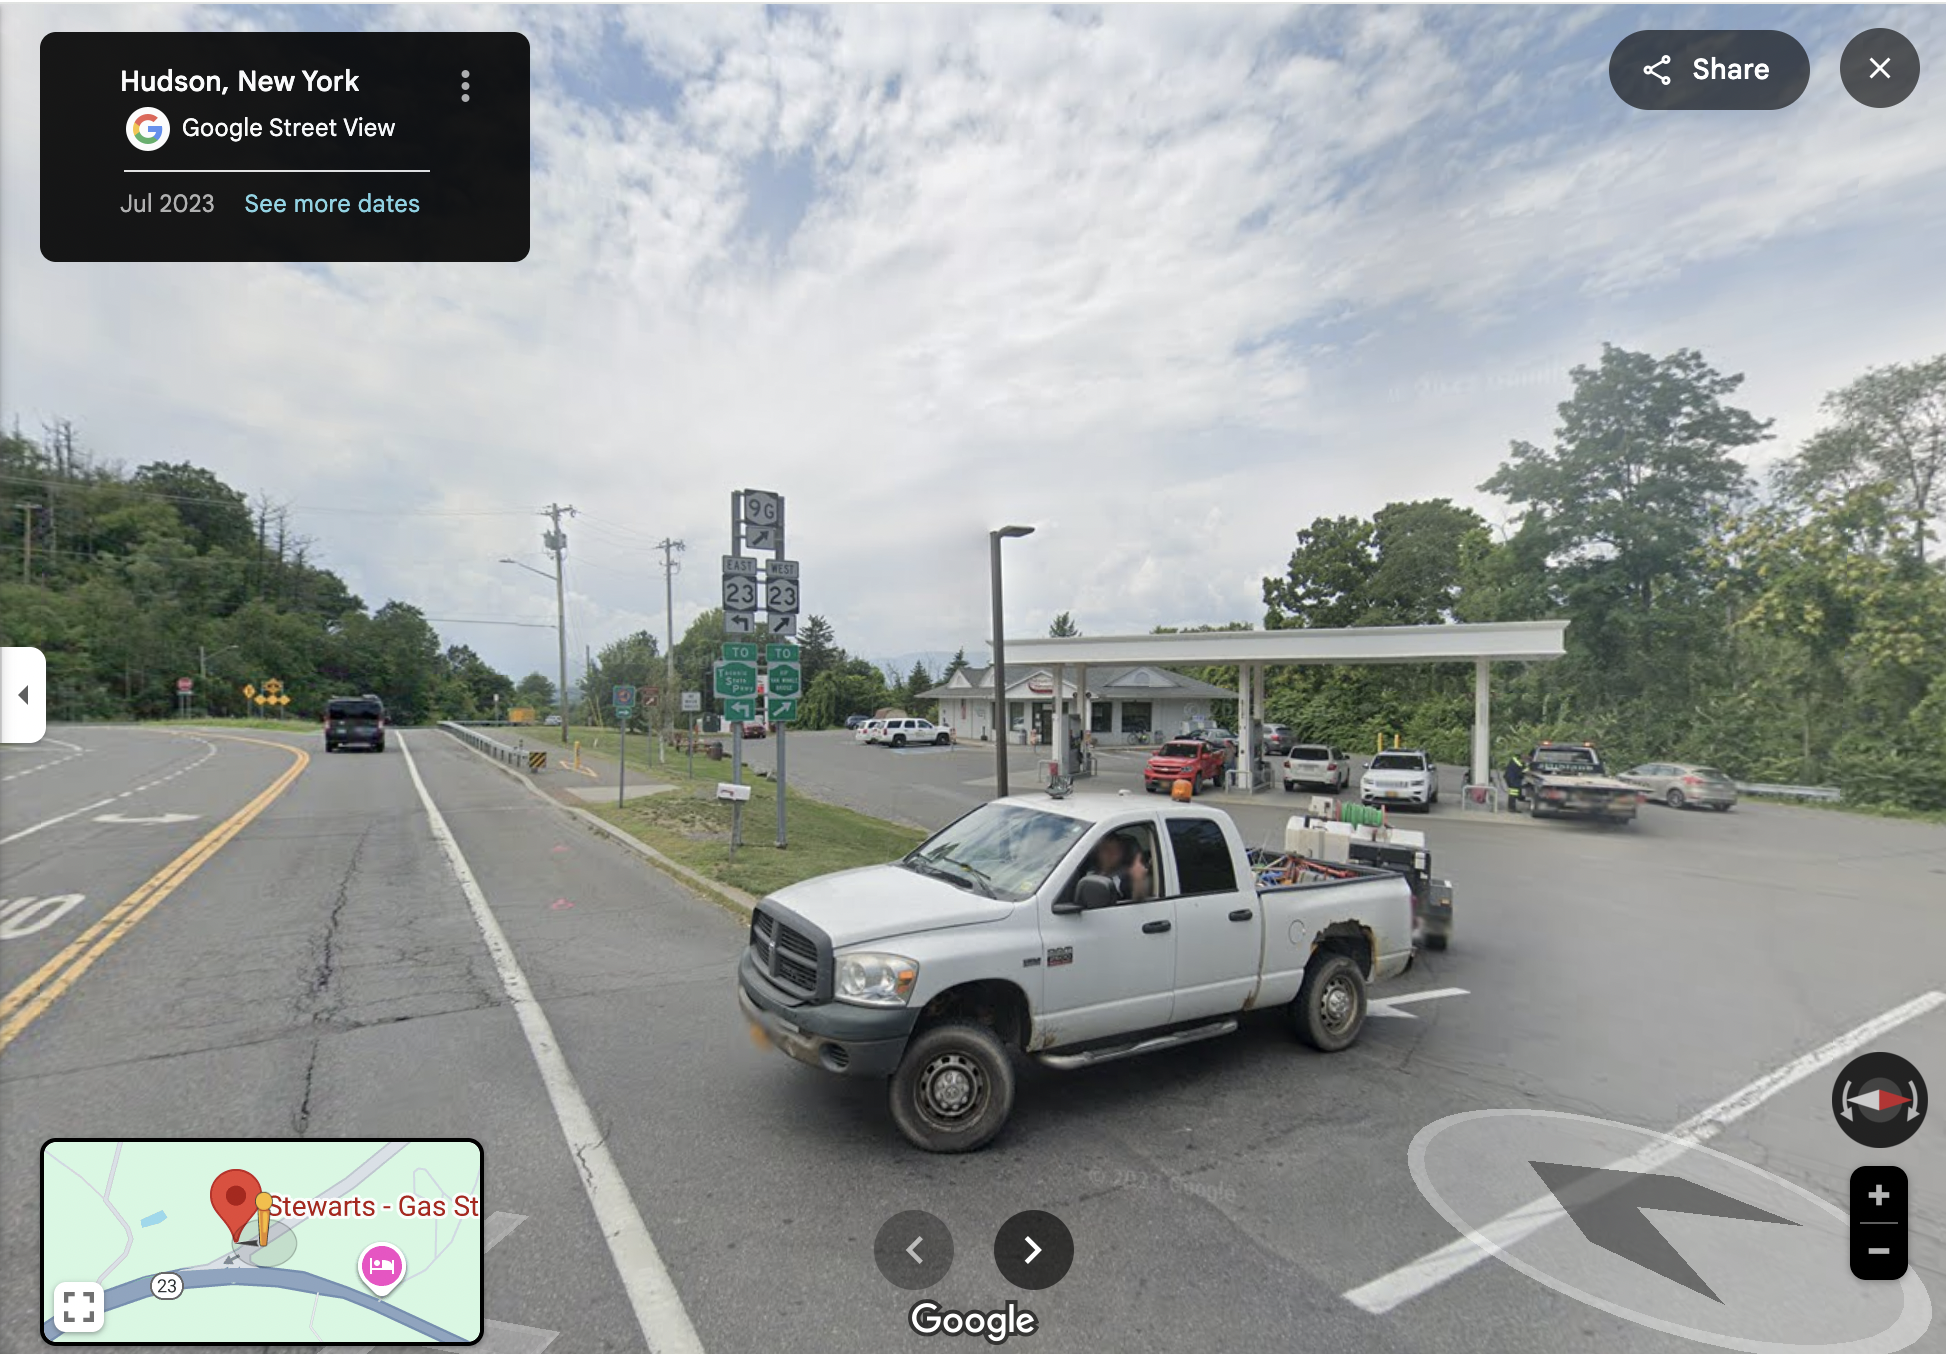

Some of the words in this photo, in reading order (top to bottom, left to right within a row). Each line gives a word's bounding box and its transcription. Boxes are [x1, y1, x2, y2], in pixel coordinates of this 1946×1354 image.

[726, 560, 752, 571] EAST
[771, 563, 794, 574] WEST
[726, 583, 754, 603] 23
[769, 586, 796, 606] 23
[732, 647, 749, 657] TO
[774, 648, 791, 659] TO
